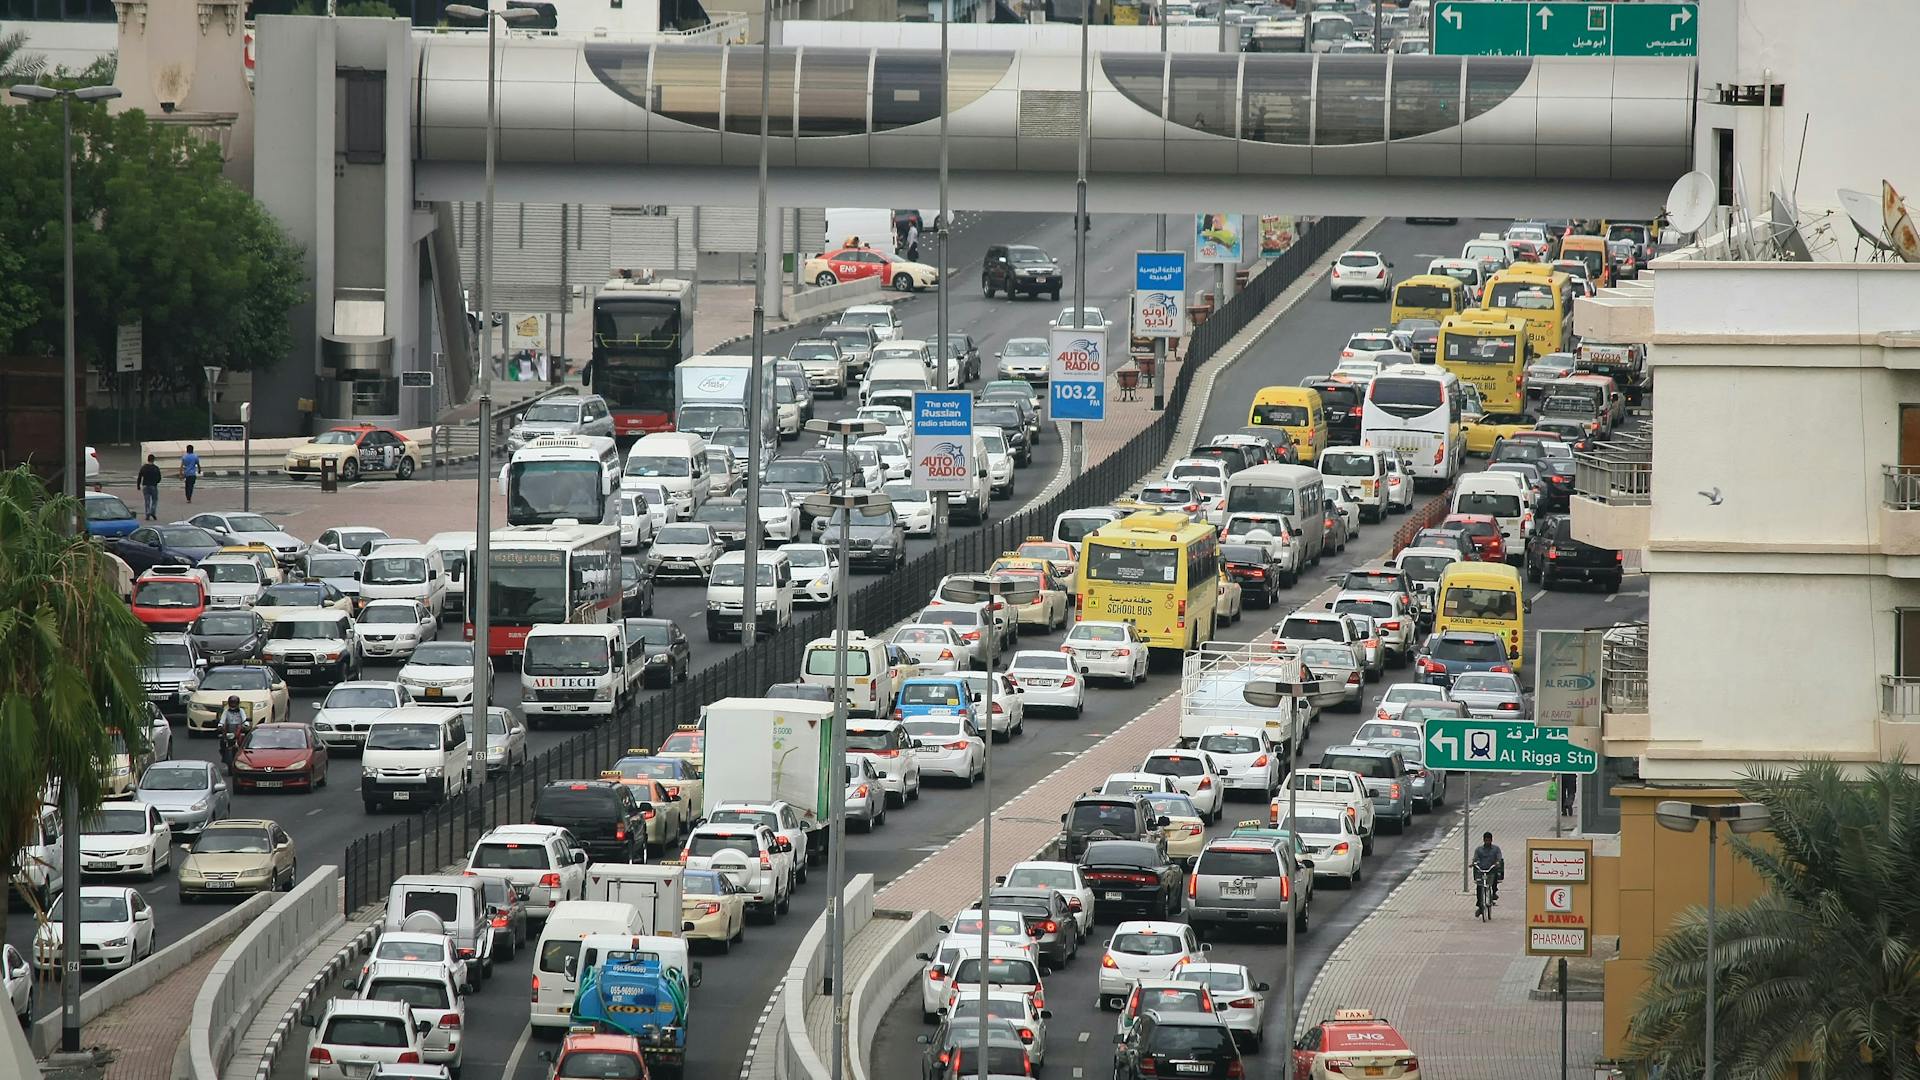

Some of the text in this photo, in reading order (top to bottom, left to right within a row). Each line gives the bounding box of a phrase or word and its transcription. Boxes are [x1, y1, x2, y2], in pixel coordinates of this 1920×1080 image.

[1646, 37, 1692, 48] القصيص
[839, 264, 857, 273] ENG
[1144, 316, 1174, 328] راديو
[1529, 333, 1546, 341] Bus
[1057, 351, 1088, 362] AUTO
[1590, 352, 1621, 360] TOYOTA
[1065, 361, 1100, 371] RADIO
[1484, 382, 1497, 390] BUS
[1054, 384, 1097, 400] 103.2
[925, 400, 960, 410] The only
[1089, 399, 1101, 407] FM
[921, 408, 961, 418] Russian
[917, 419, 967, 427] radio station
[919, 456, 953, 467] AUTO
[928, 466, 967, 477] RADIO
[1109, 594, 1152, 604] حافلة مدرسية
[1107, 603, 1153, 616] SCHOOL BUS
[1545, 679, 1556, 688] AL
[778, 727, 793, 735] GOOD
[1506, 726, 1539, 743] الرقة
[1500, 749, 1593, 766] Al Rigga Stn
[1533, 853, 1584, 866] صيدلية
[1534, 867, 1583, 878] الروضة
[1533, 915, 1585, 924] AL RAWDA
[1533, 934, 1583, 946] PHARMACY
[68, 963, 78, 972] 64
[1346, 1033, 1385, 1041] ENG
